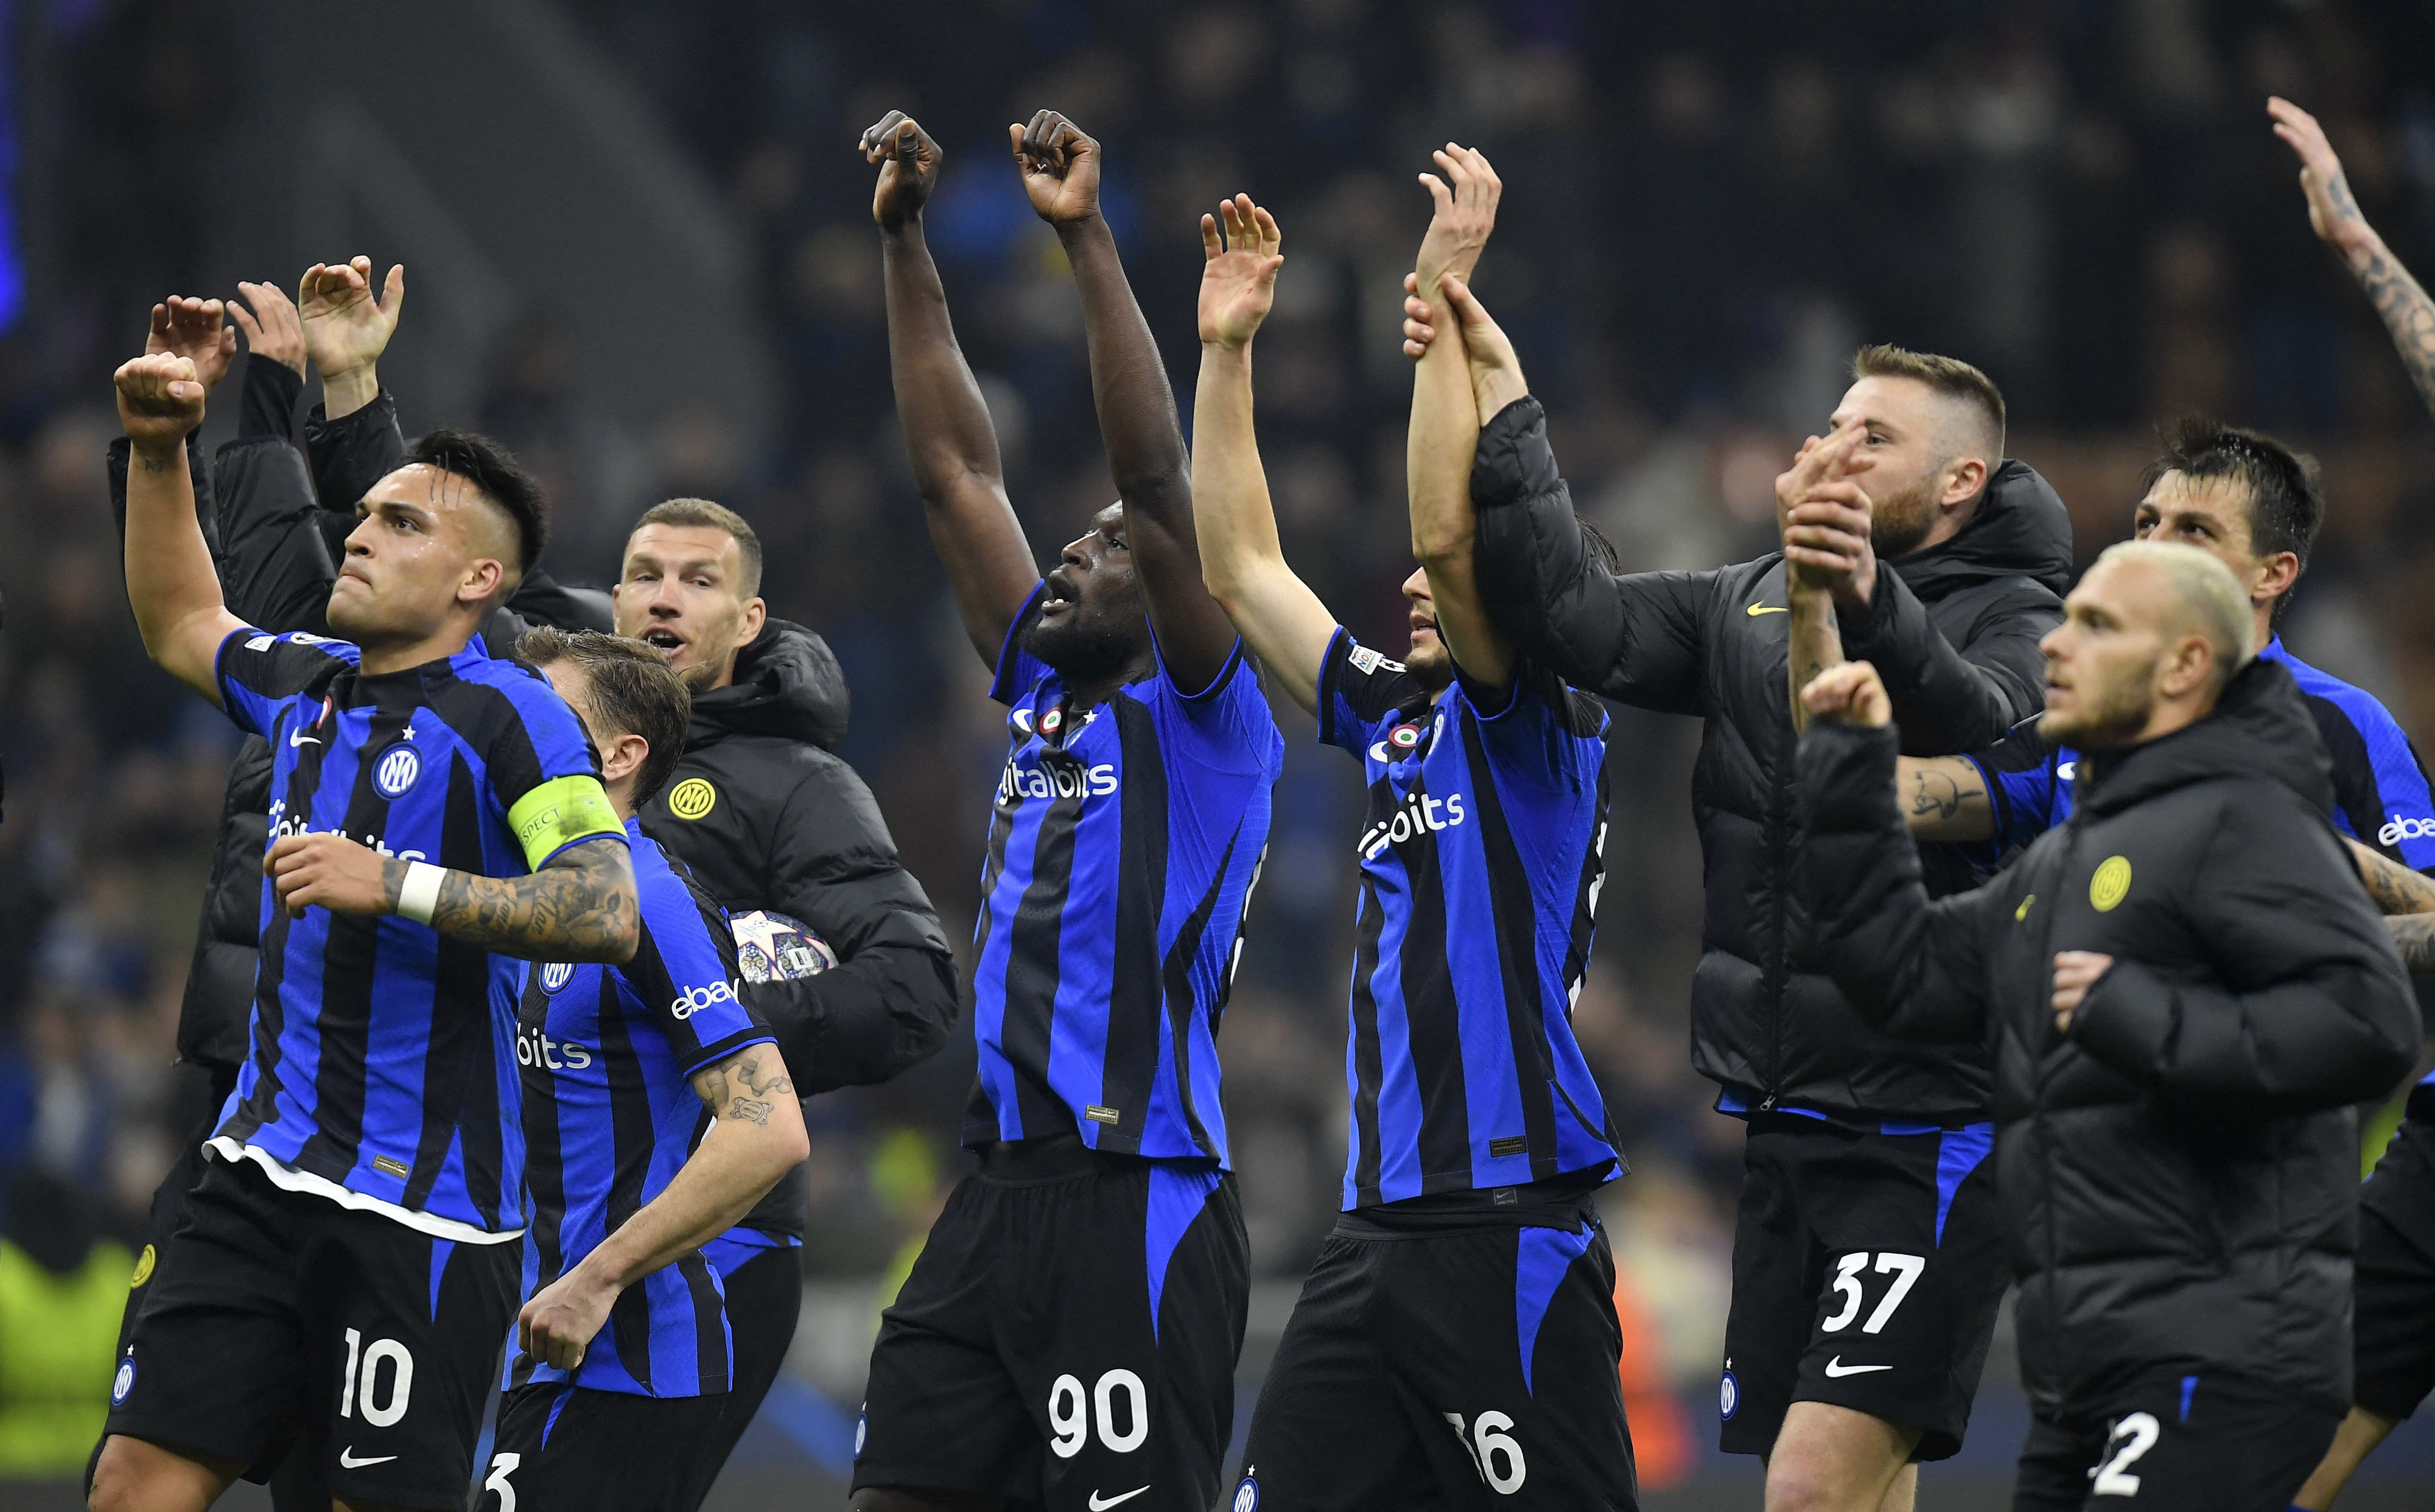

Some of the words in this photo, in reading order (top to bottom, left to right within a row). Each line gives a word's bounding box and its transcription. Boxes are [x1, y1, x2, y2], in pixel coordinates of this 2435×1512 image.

[519, 807, 561, 844] SPECT
[671, 978, 740, 1020] ebay
[517, 1022, 591, 1069] bits
[1821, 1252, 1926, 1334] 37
[340, 1328, 413, 1427] 10
[1049, 1368, 1149, 1458] 90
[485, 1452, 520, 1512] 3
[2087, 1411, 2160, 1498] 2
